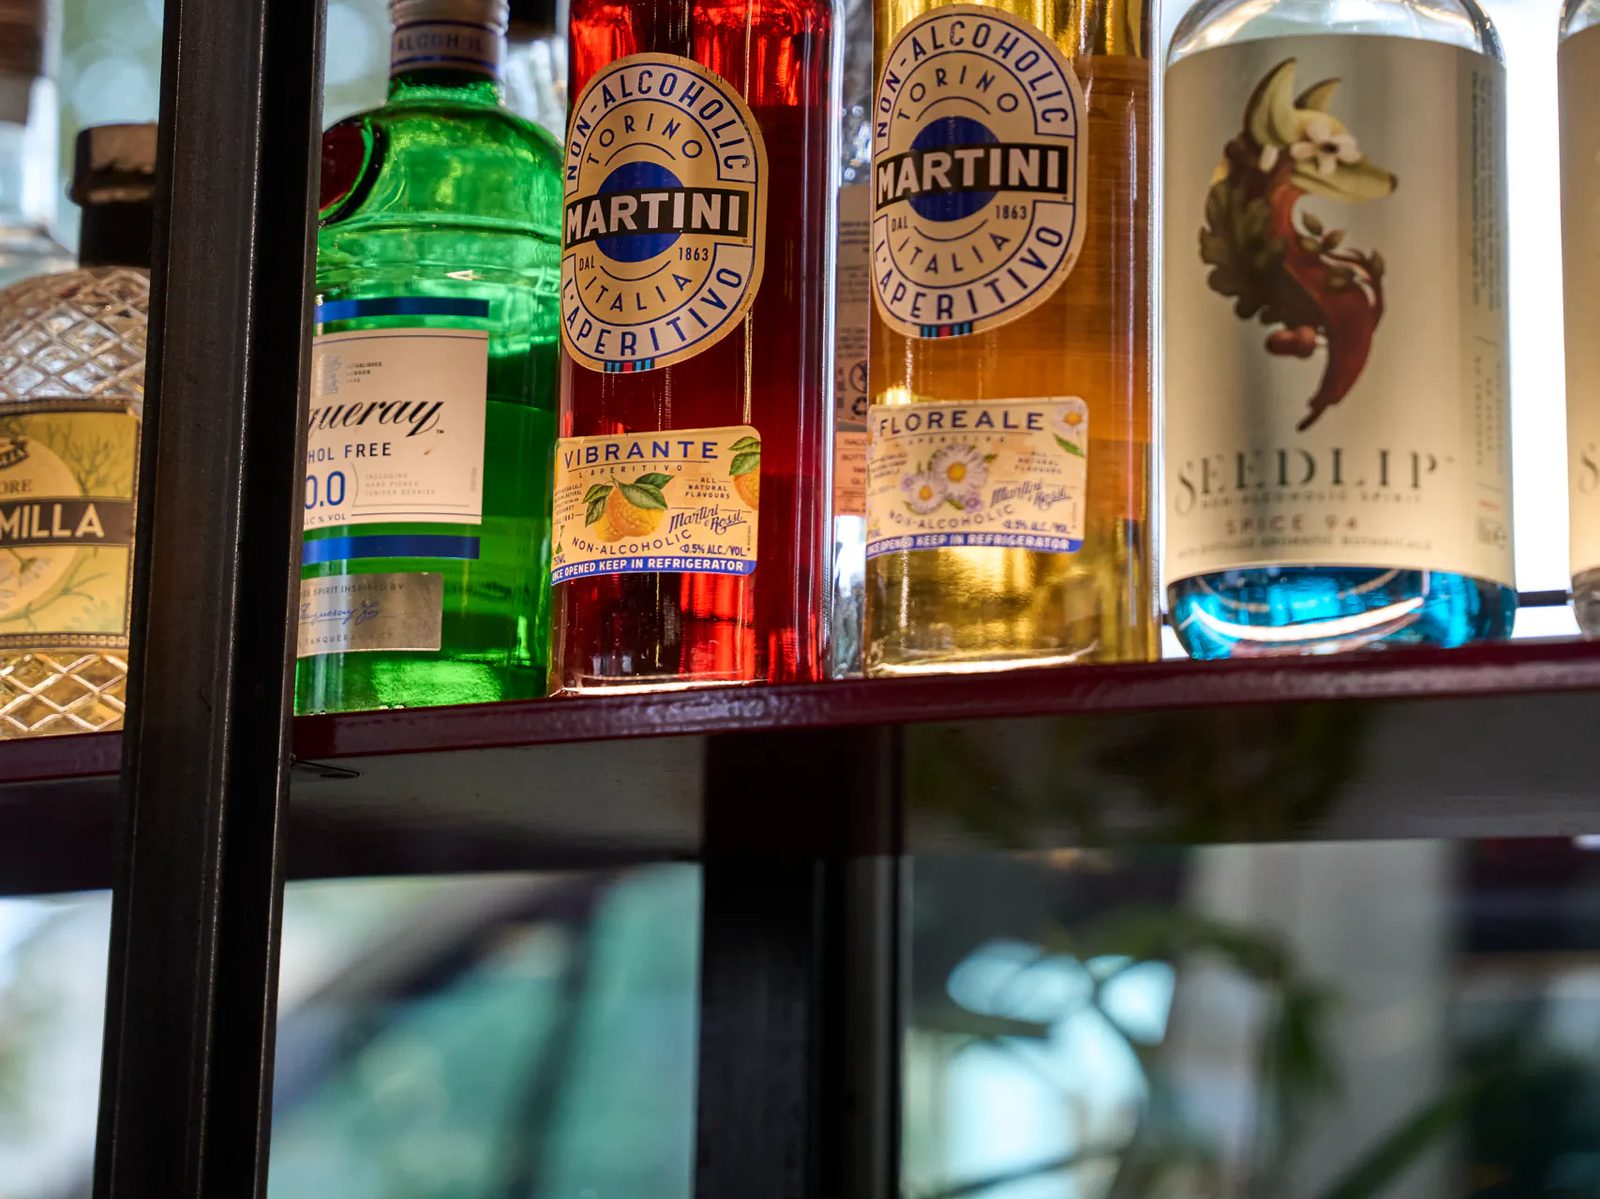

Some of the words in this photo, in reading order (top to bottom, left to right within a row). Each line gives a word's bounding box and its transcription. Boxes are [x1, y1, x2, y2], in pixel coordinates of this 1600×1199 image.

[877, 20, 1069, 138] NON-ALCOHOLIC
[897, 65, 1019, 121] TORINO
[566, 70, 751, 181] NON-ALCOHOLIC
[586, 113, 703, 165] TORINO
[878, 148, 1059, 204] MARTINI
[566, 192, 741, 244] MARTINI
[891, 215, 908, 232] DAL
[995, 205, 1027, 220] 1863
[579, 255, 595, 272] DAL
[678, 247, 709, 262] 1863
[898, 232, 1011, 275] ITALIA
[585, 273, 693, 312] ITALIA
[879, 410, 1044, 437] FLOREALE
[308, 447, 335, 463] HOL
[345, 442, 392, 459] FREE
[564, 441, 719, 469] VIBRANTE
[304, 470, 346, 510] 0.0
[685, 491, 730, 499] FLAVOURS
[1174, 446, 1439, 517] SEEDLIP
[0, 503, 105, 540] MILLA
[328, 513, 346, 521] VOL
[668, 503, 719, 534] Martini
[710, 508, 747, 536] Rossi
[1226, 514, 1305, 536] SPICE
[1325, 515, 1359, 530] 94
[572, 529, 692, 555] NON-ALCOHOLIC
[564, 562, 595, 576] OPENED
[599, 559, 627, 570] KEEP
[631, 558, 643, 569] IN
[649, 558, 744, 571] REFRIGERATOR
[313, 585, 339, 596] SPIRIT
